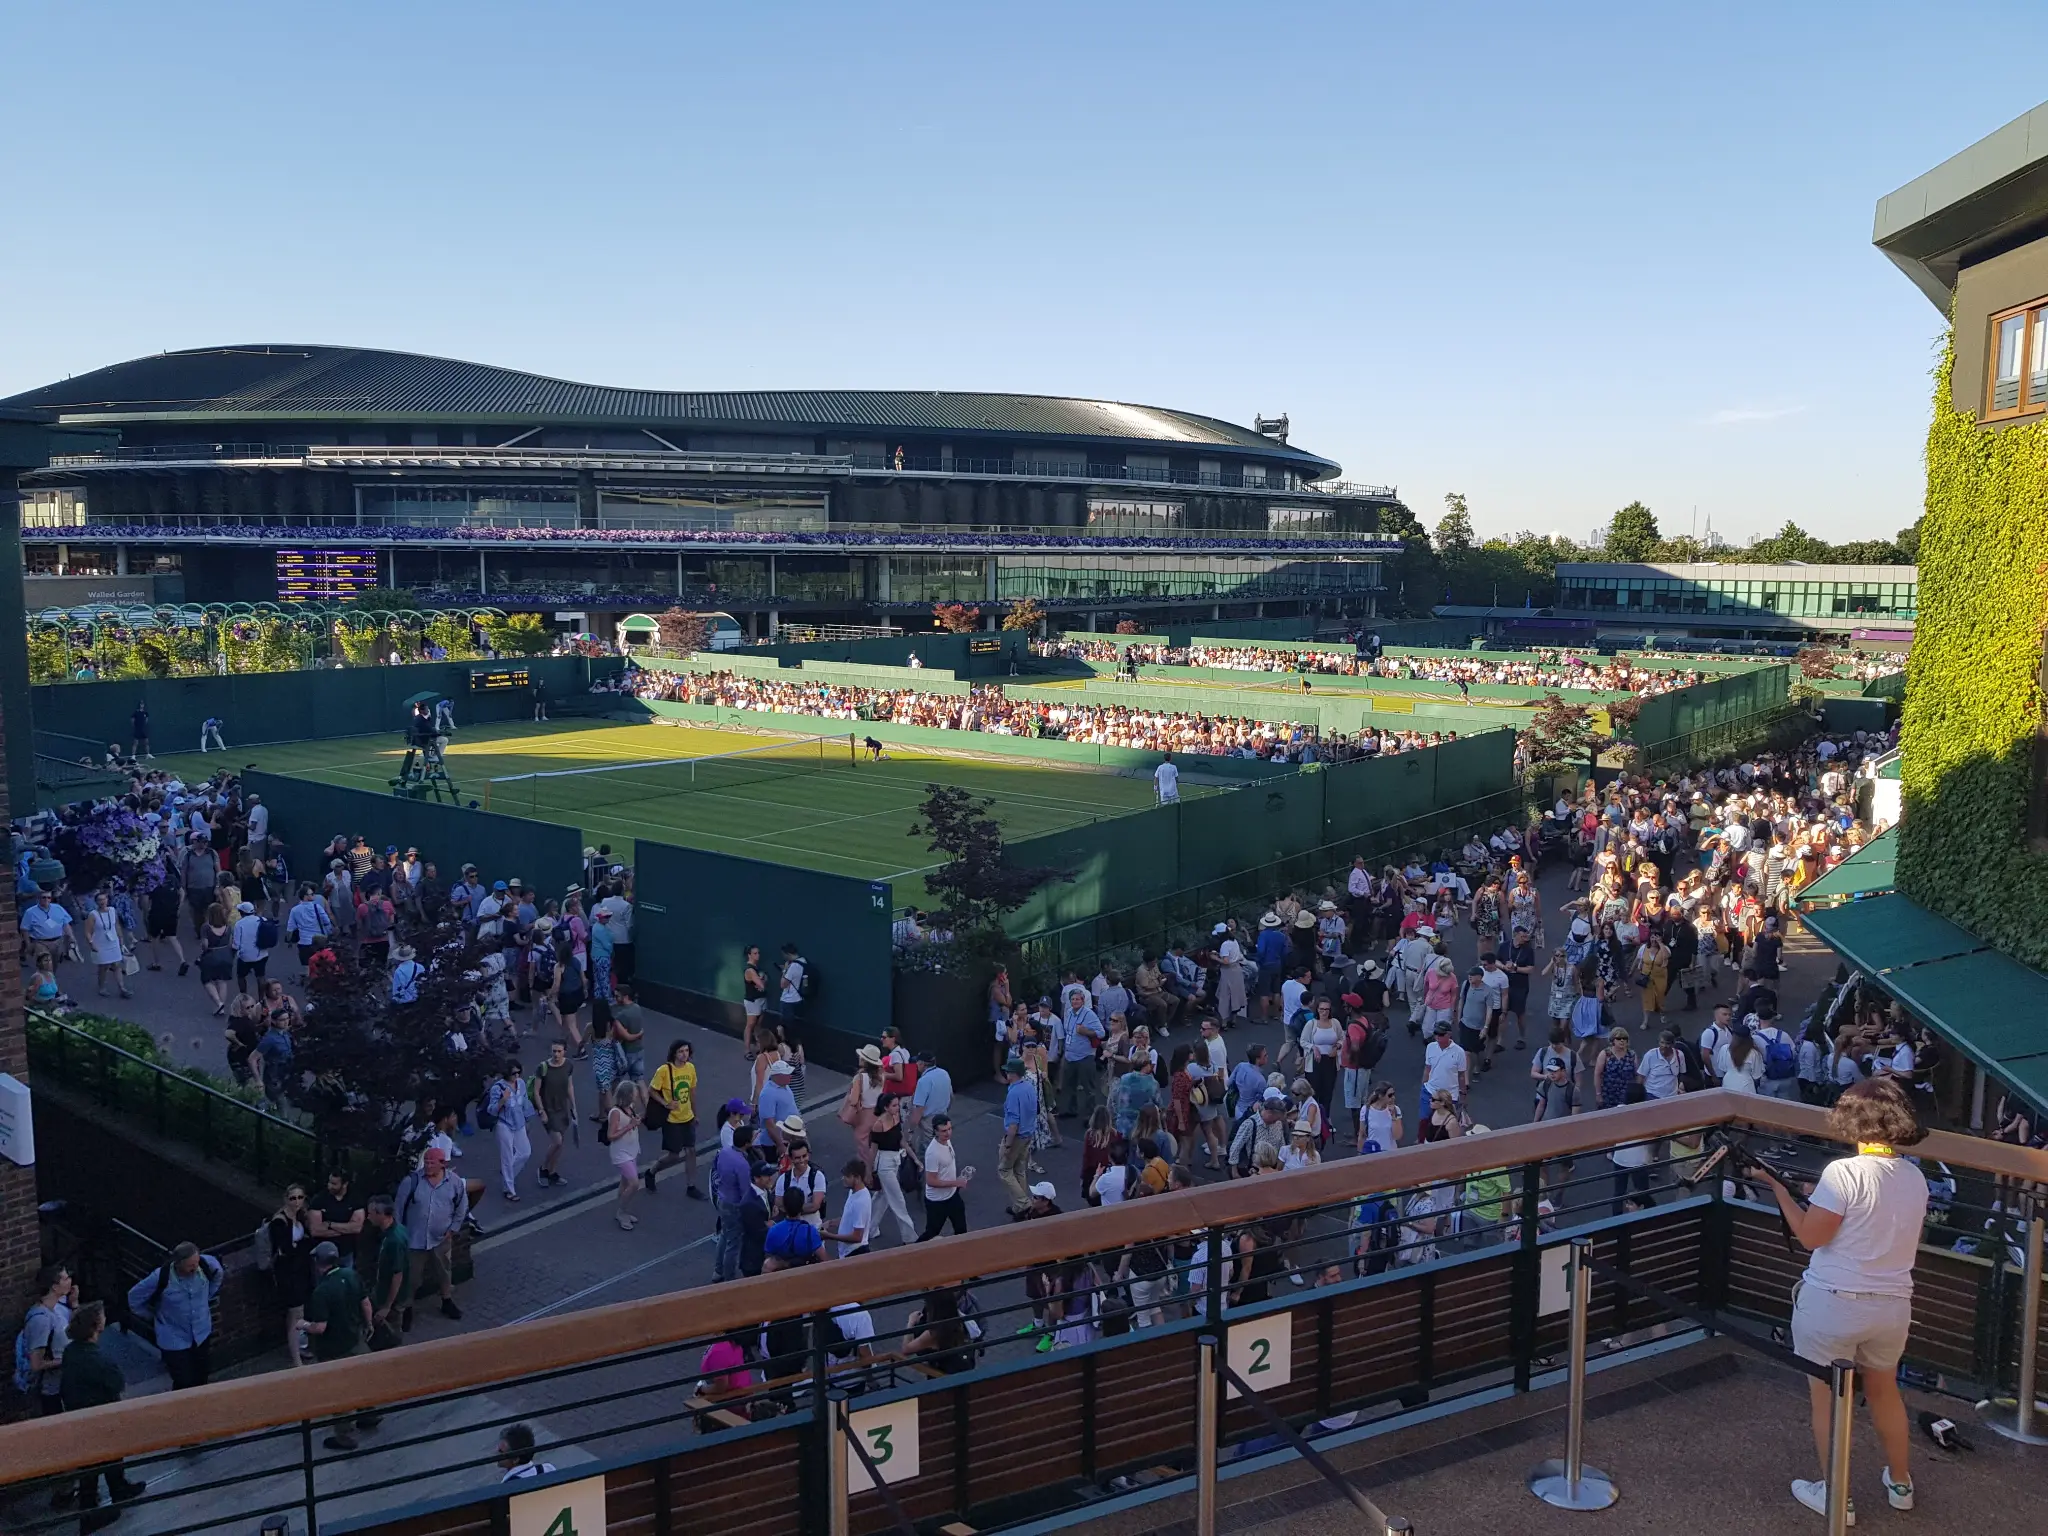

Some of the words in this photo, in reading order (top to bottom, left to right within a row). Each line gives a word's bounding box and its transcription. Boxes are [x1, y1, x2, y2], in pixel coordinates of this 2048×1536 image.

[872, 896, 884, 908] 14
[1248, 1338, 1270, 1375] 2
[867, 1424, 893, 1465] 3
[543, 1506, 578, 1536] 4
